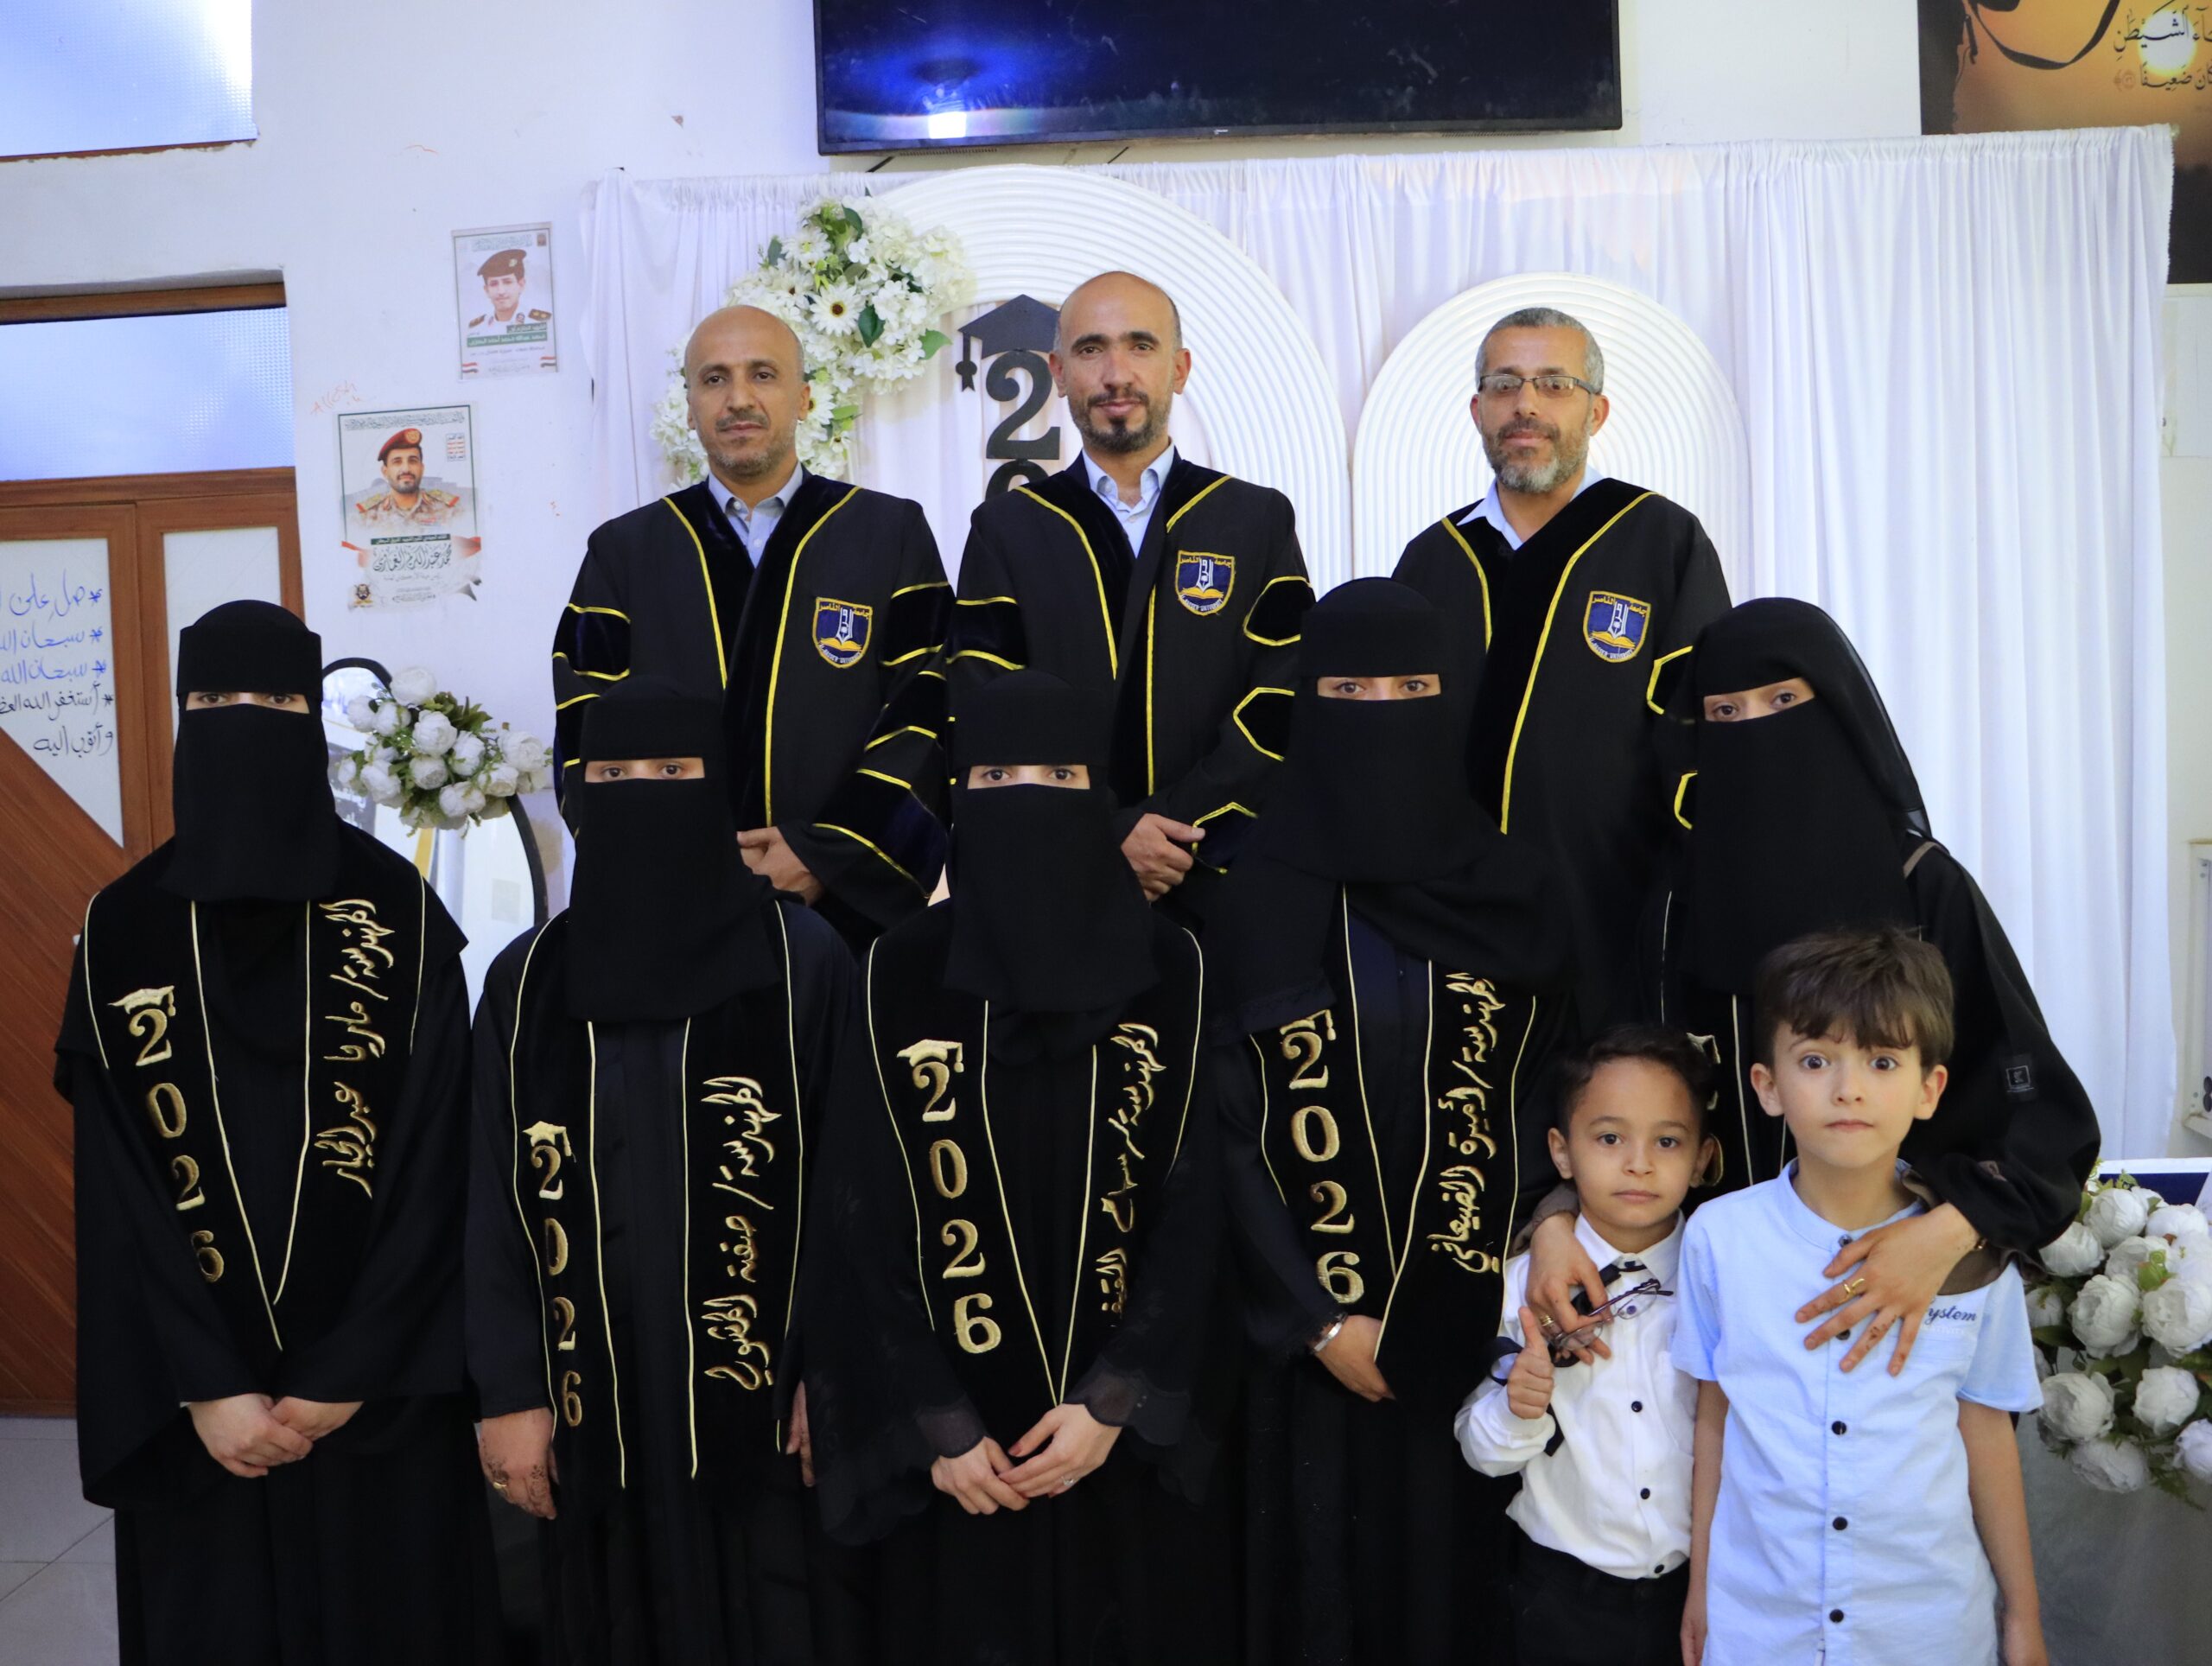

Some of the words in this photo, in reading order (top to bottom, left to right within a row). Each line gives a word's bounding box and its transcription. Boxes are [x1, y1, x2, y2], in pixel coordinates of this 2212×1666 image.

[21, 619, 85, 649] سبحان
[1, 659, 27, 684] الله
[29, 657, 88, 682] سبحان
[23, 691, 51, 710] الله
[324, 1001, 385, 1060] ماريا
[1437, 1086, 1497, 1160] أميرة
[129, 1008, 225, 1283] 2026
[1282, 1032, 1364, 1303] 2026
[912, 1061, 1001, 1354] 2026
[1924, 1300, 1978, 1326] ystem
